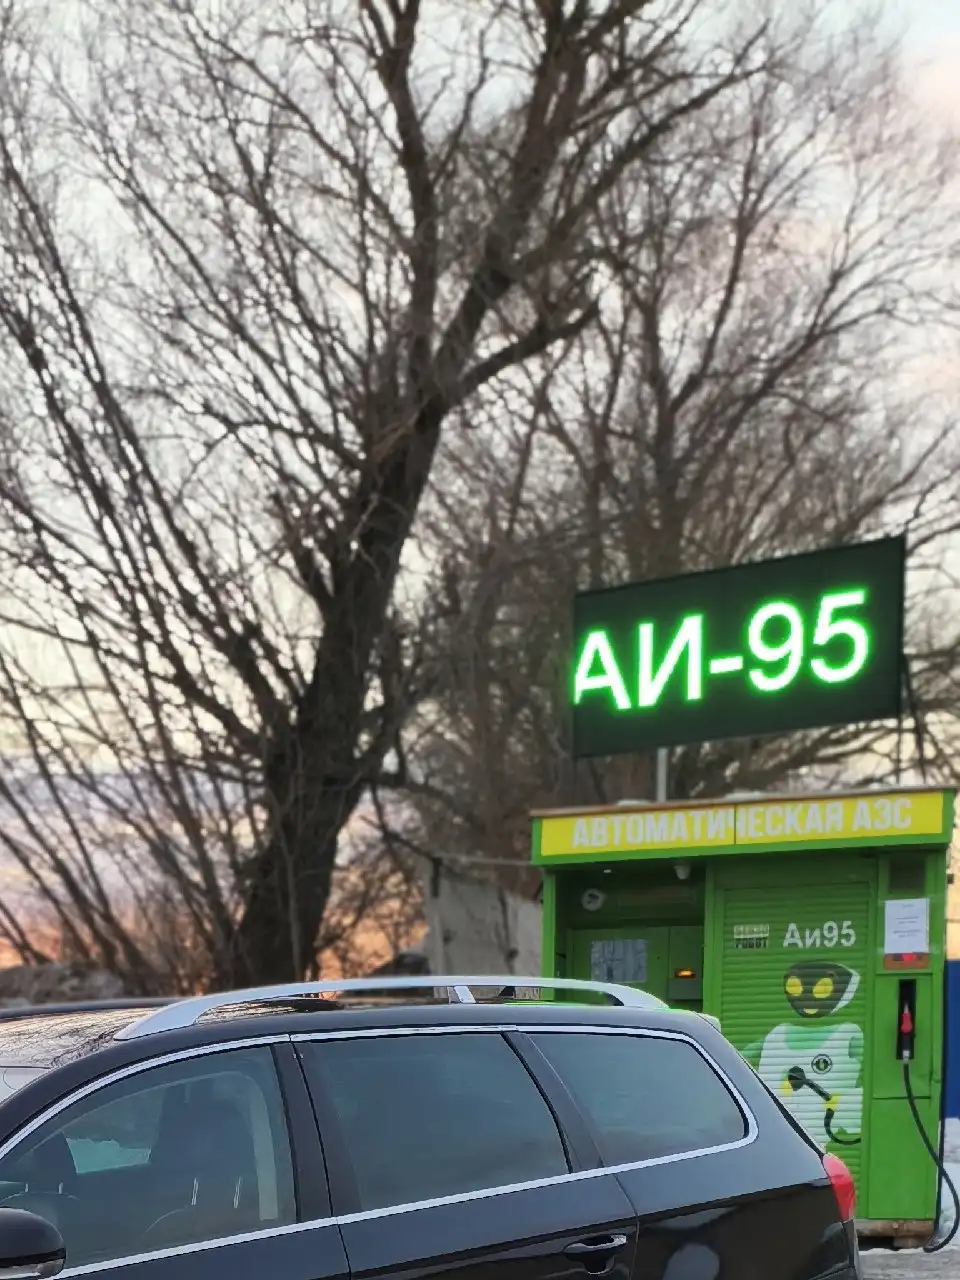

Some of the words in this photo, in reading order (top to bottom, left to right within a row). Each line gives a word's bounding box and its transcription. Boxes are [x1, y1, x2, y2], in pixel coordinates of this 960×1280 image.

[573, 589, 870, 710] АИ-95
[572, 801, 844, 848] АВТОМАТИЧЕСКАЯ
[852, 798, 912, 832] АЗС
[783, 920, 856, 949] Аи95
